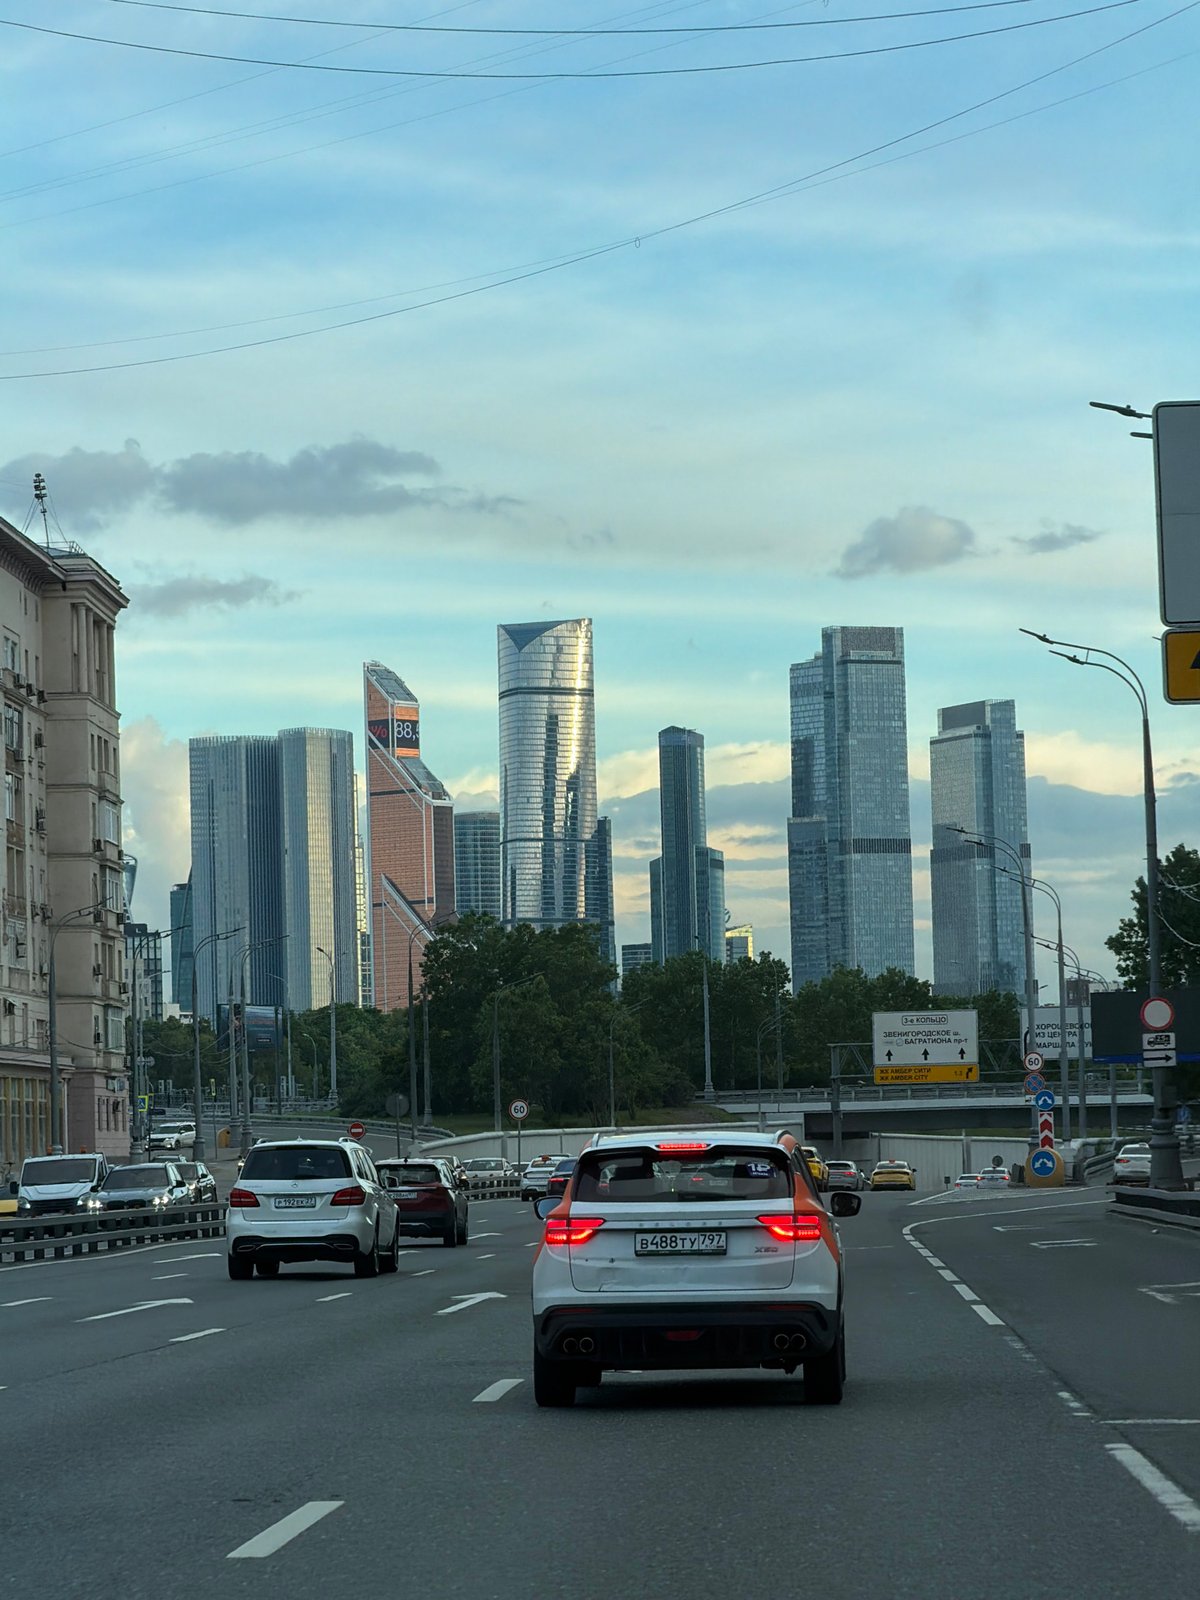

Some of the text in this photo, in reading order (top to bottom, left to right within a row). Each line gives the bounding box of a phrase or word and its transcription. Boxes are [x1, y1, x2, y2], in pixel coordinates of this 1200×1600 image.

[883, 1030, 951, 1038] ЗВЕНИГОРОДСКОЕ
[1028, 1057, 1040, 1066] 60
[513, 1105, 525, 1114] 60
[700, 1233, 722, 1245] 797
